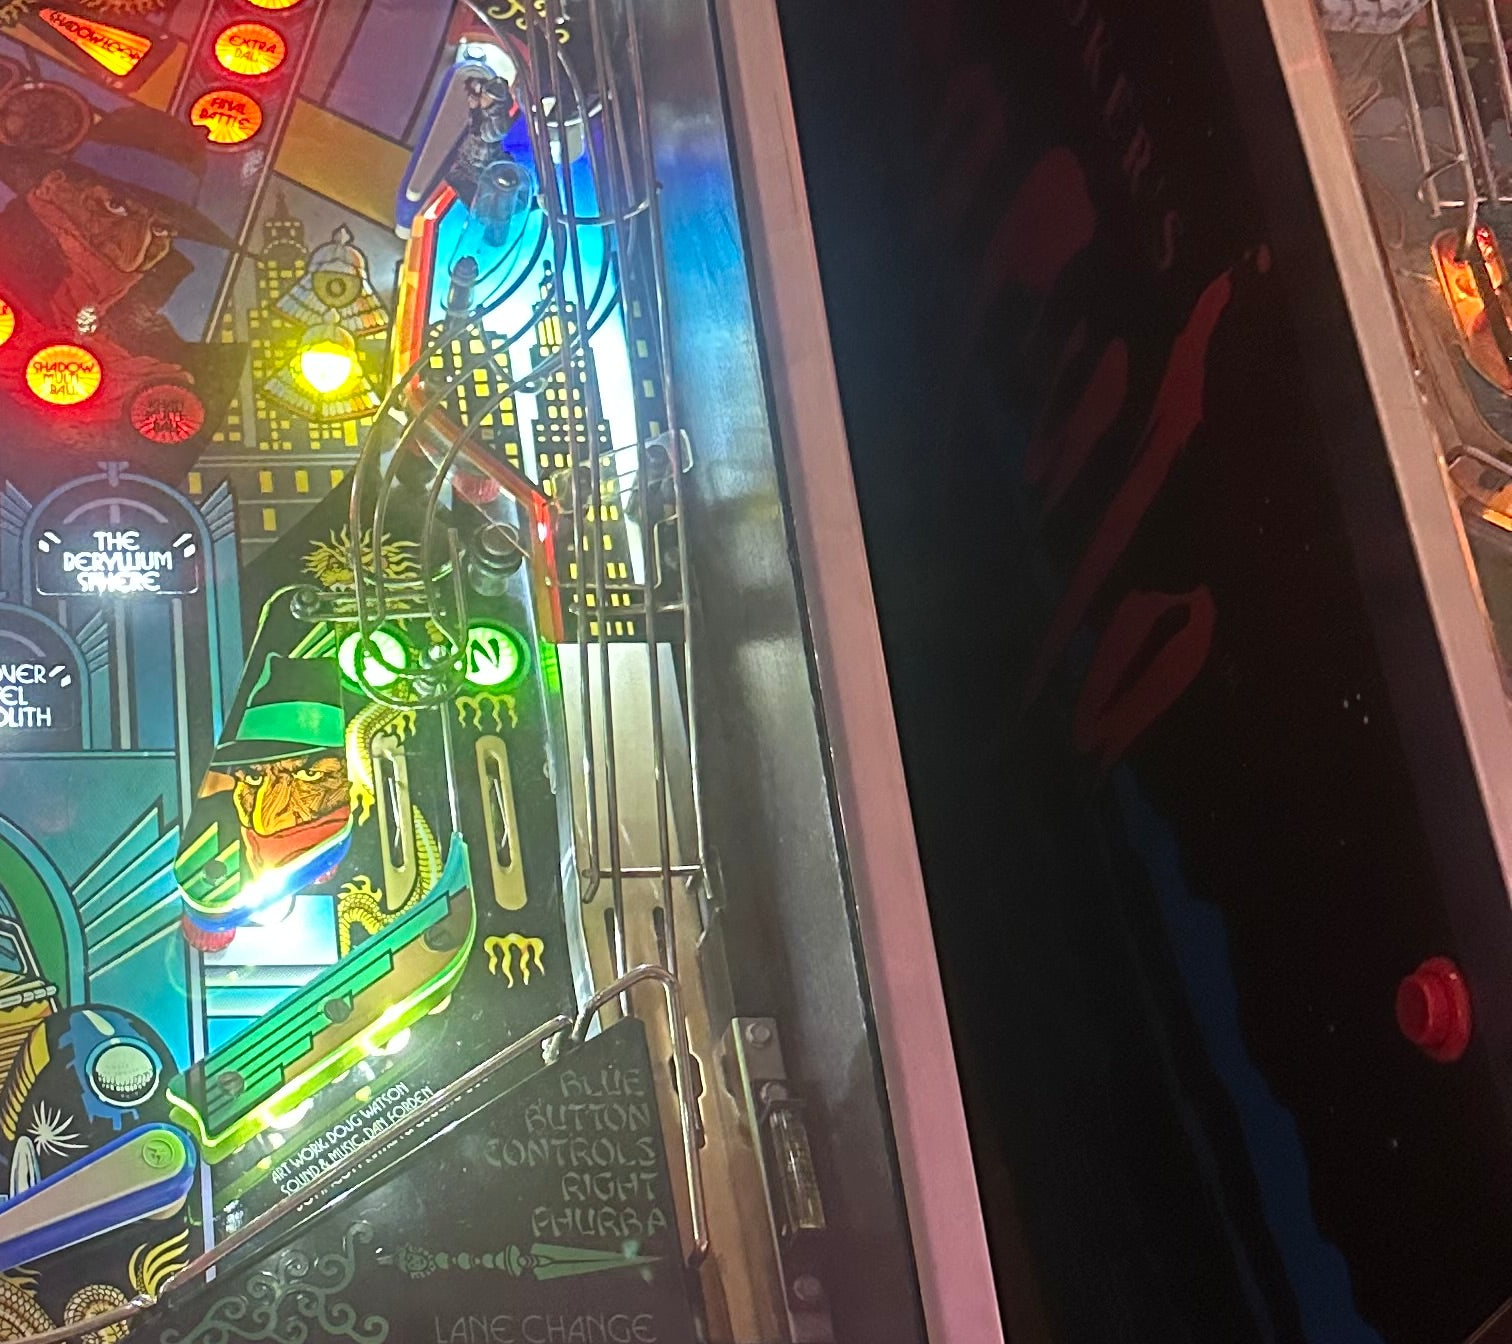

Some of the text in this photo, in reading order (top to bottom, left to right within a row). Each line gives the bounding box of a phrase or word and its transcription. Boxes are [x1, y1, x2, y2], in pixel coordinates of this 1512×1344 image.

[229, 35, 278, 55] EXTRA
[33, 361, 95, 374] SHADOW
[93, 530, 140, 551] THE
[76, 571, 161, 593] SPHERE
[560, 1068, 644, 1098] BLUE
[269, 1162, 292, 1184] ART
[325, 1113, 363, 1144] DOUG
[358, 1081, 409, 1121] WATSON
[524, 1102, 651, 1134] BUTTON
[279, 1163, 322, 1197] SOUND
[363, 1117, 388, 1139] DAN
[385, 1086, 435, 1124] FORDEN
[486, 1136, 658, 1168] CONTROLS
[561, 1171, 659, 1202] RIGHT
[531, 1206, 667, 1238] PHURBA
[435, 1313, 658, 1344] LANE CHANGE
